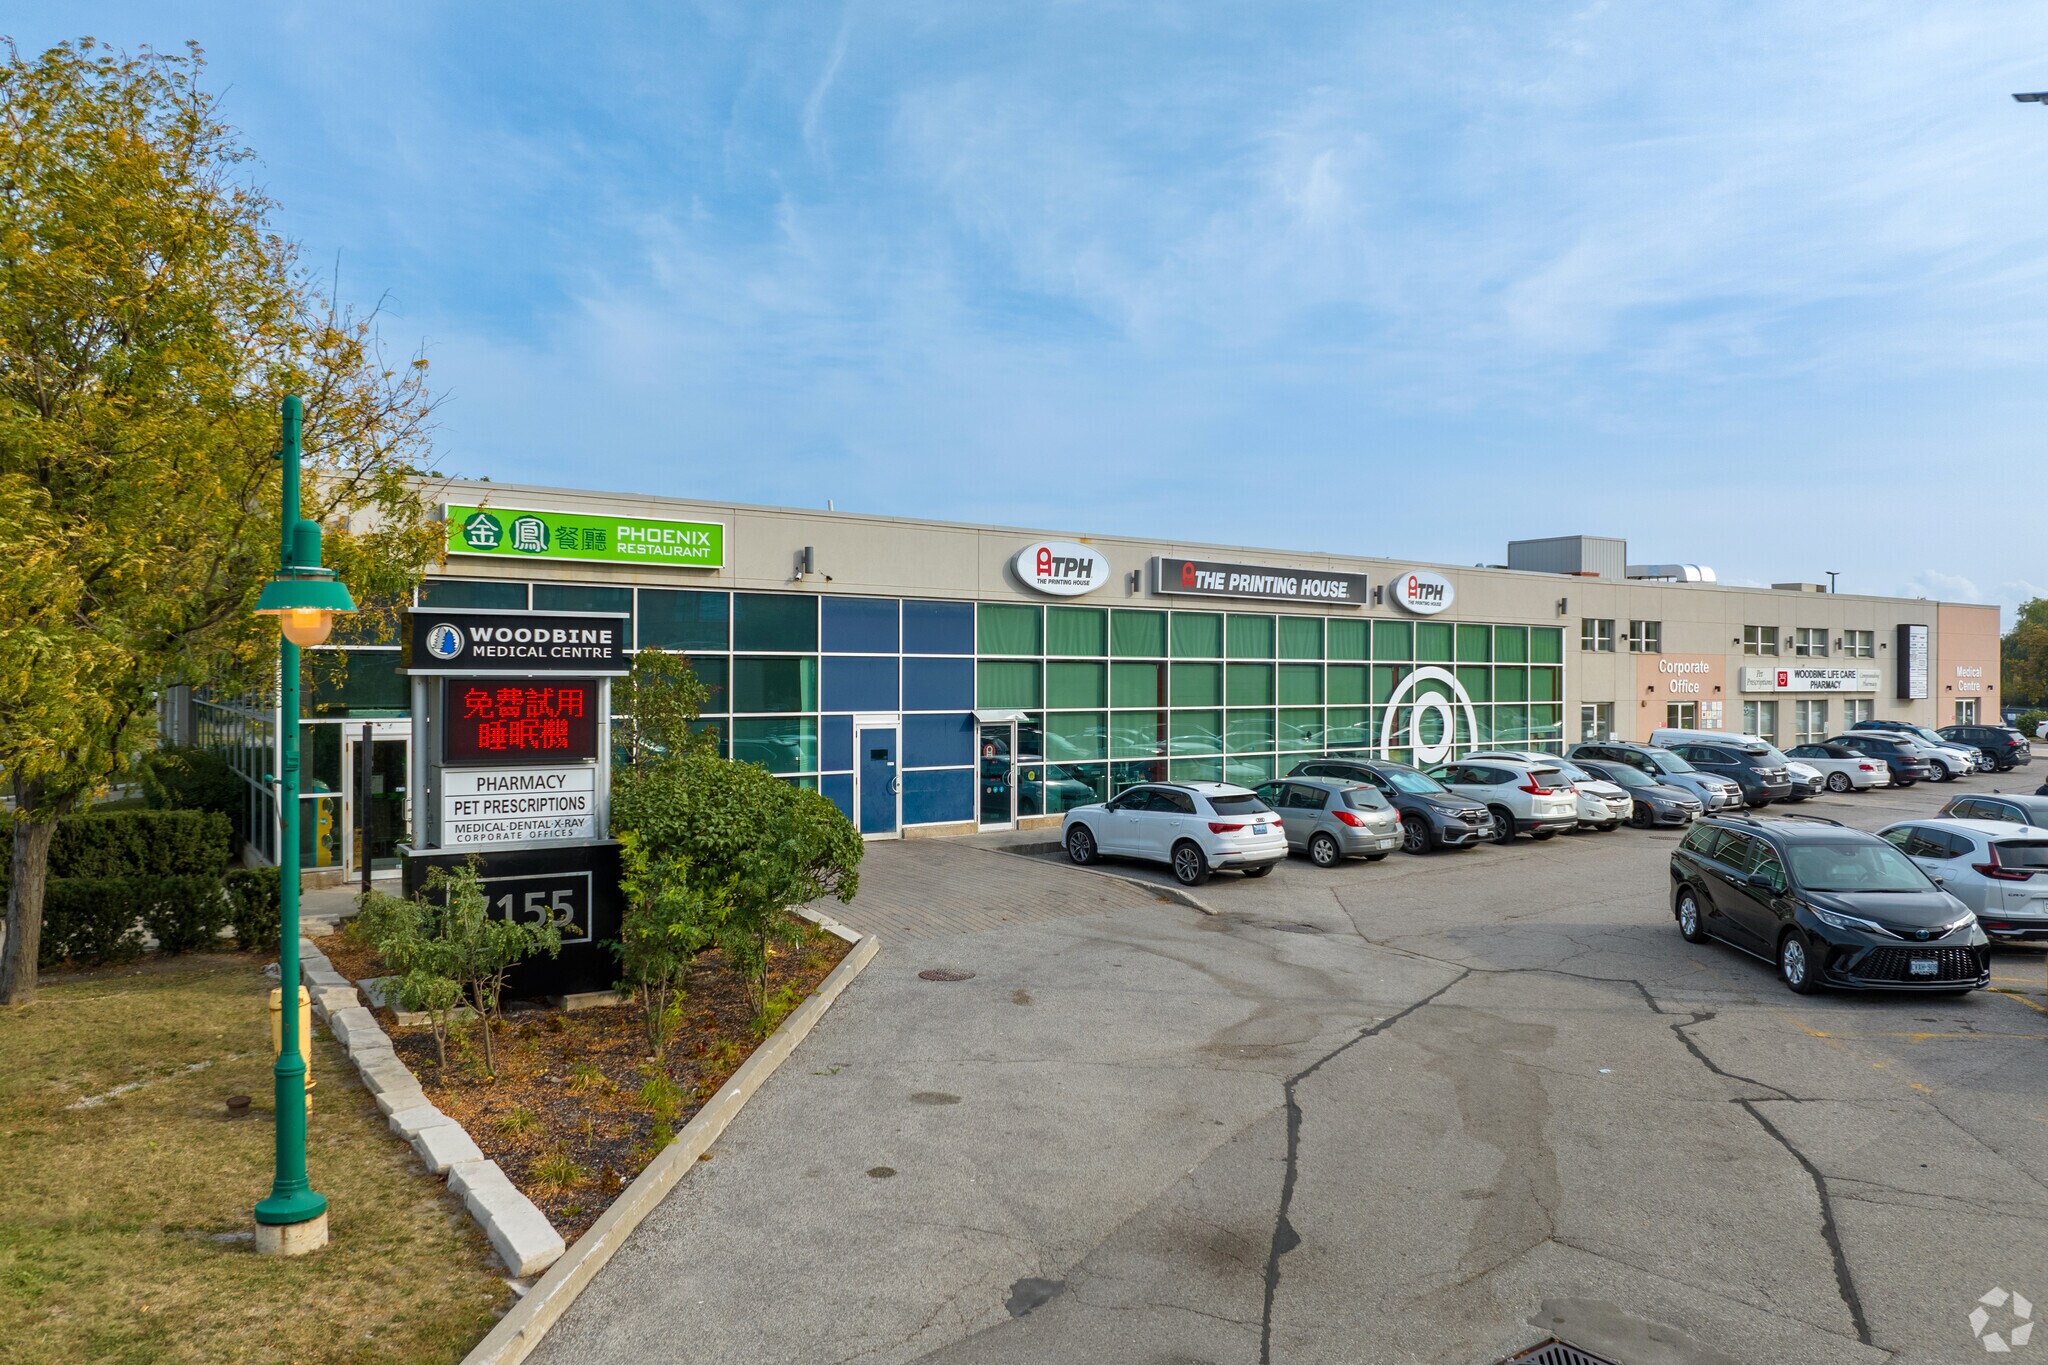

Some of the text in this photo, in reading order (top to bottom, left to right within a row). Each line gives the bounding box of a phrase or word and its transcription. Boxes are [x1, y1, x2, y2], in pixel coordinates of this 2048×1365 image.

[466, 513, 607, 552] 金鳳餐廳
[617, 525, 711, 546] PHOENIX
[617, 543, 711, 558] RESTAURANT
[1194, 570, 1348, 598] THE PRINTING HOUSE
[469, 627, 612, 644] WOODBINE
[473, 645, 612, 659] MEDICAL CENTRE
[1659, 659, 1710, 676] Corporate
[1794, 669, 1826, 679] WOODBINE
[1827, 670, 1840, 679] LIFE
[1840, 670, 1856, 679] CARE
[1956, 666, 1982, 678] Medical
[1669, 679, 1700, 693] Office
[1810, 680, 1841, 689] PHARMACY
[1958, 680, 1981, 692] Centre
[463, 687, 583, 719] 免費試用
[478, 719, 569, 750] 睡眠機
[477, 774, 567, 792] PHARMACY
[454, 796, 586, 816] PET PRESCRIPTIONS
[456, 829, 574, 843] CORPORATE OFFICES
[484, 889, 574, 928] 155
